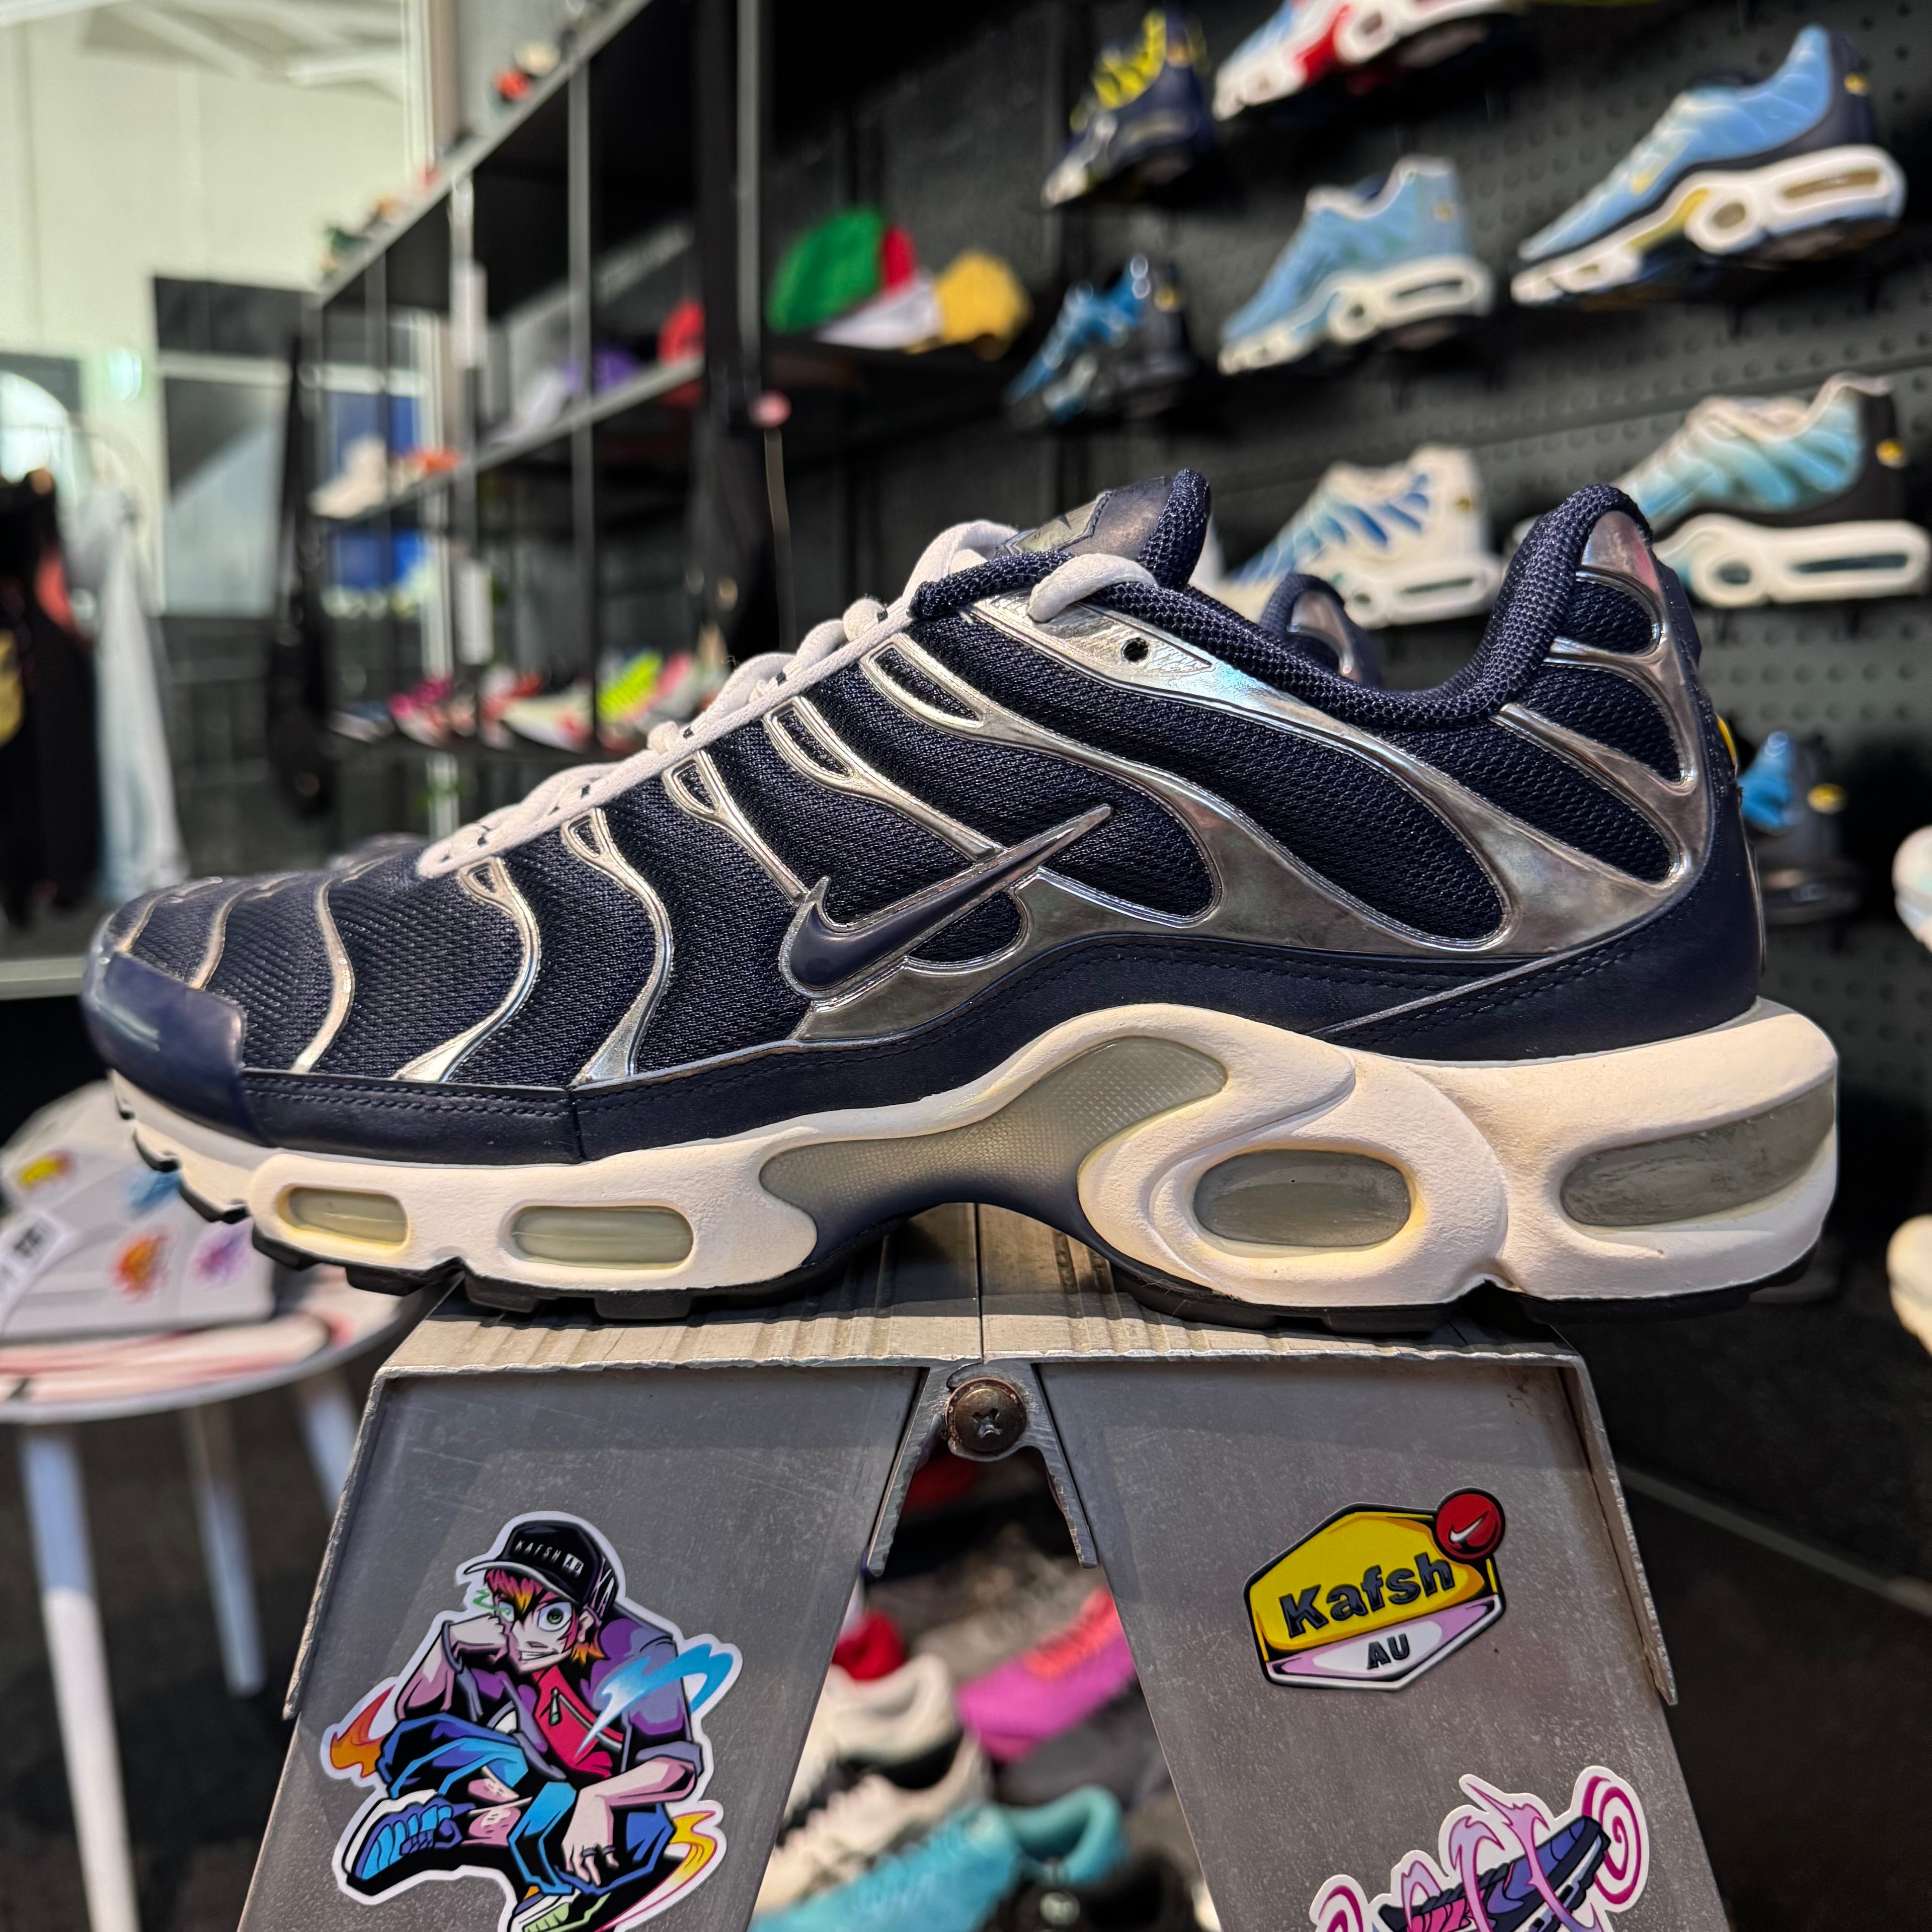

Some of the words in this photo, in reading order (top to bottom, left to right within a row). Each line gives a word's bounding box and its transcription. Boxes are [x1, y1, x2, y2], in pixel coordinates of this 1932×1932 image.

[512, 1540, 561, 1564] KAFSH
[1278, 1552, 1456, 1639] Kafsh
[1366, 1633, 1410, 1670] AU
